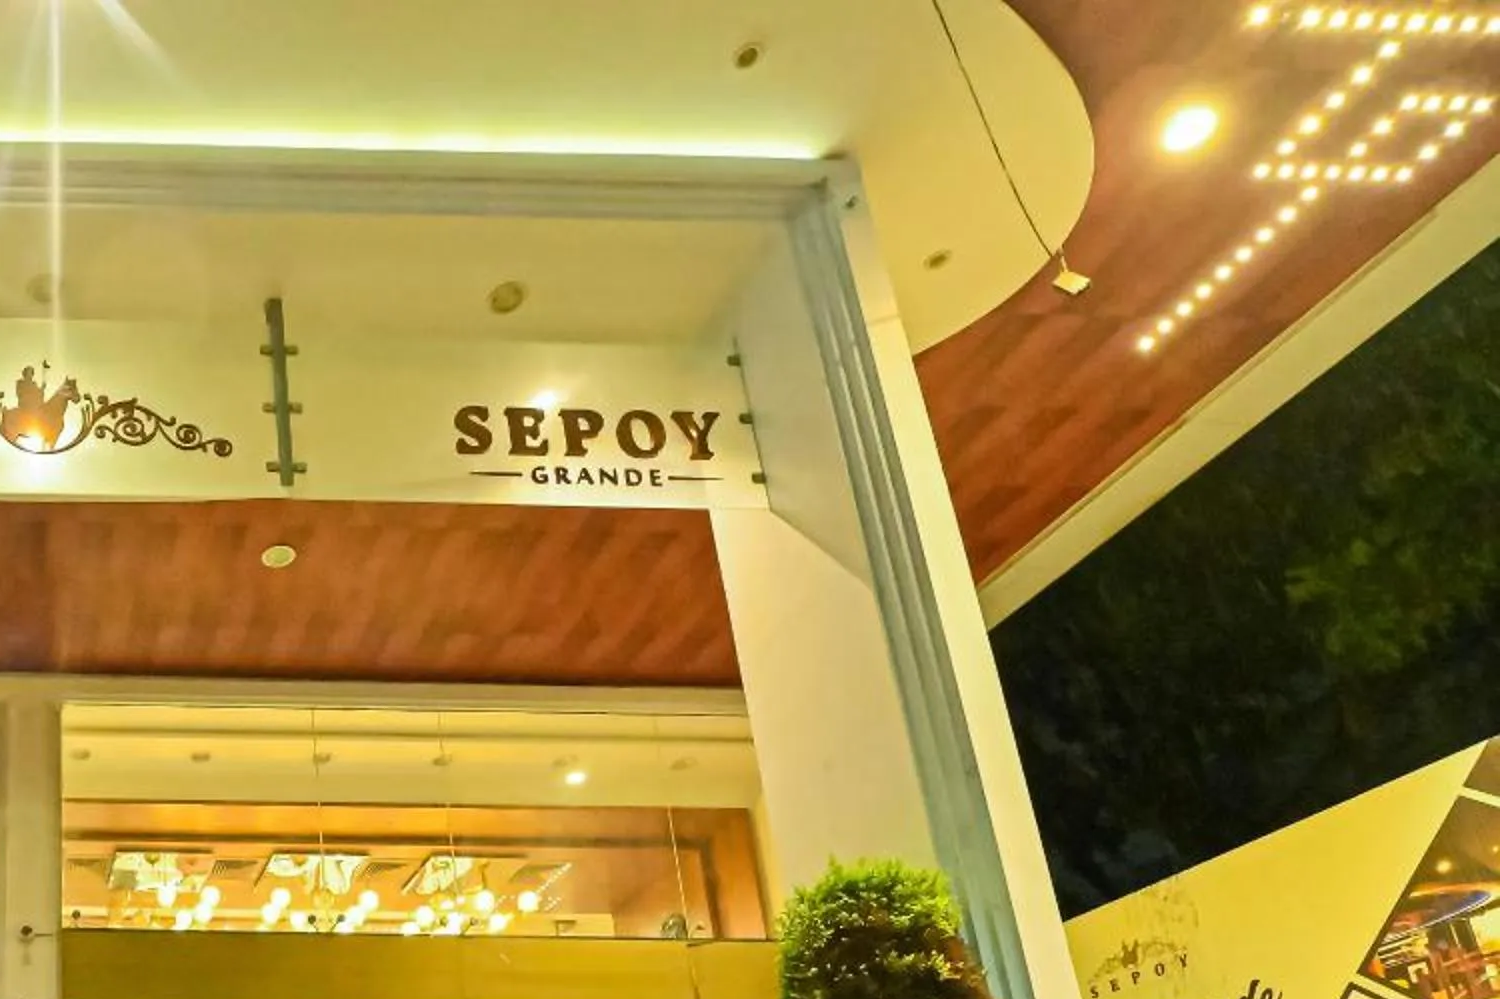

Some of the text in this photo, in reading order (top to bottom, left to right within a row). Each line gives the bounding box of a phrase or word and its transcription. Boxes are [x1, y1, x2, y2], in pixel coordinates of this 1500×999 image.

[453, 405, 721, 461] SEPOY
[530, 466, 663, 487] GRANDE
[1089, 953, 1188, 999] SEPOY
